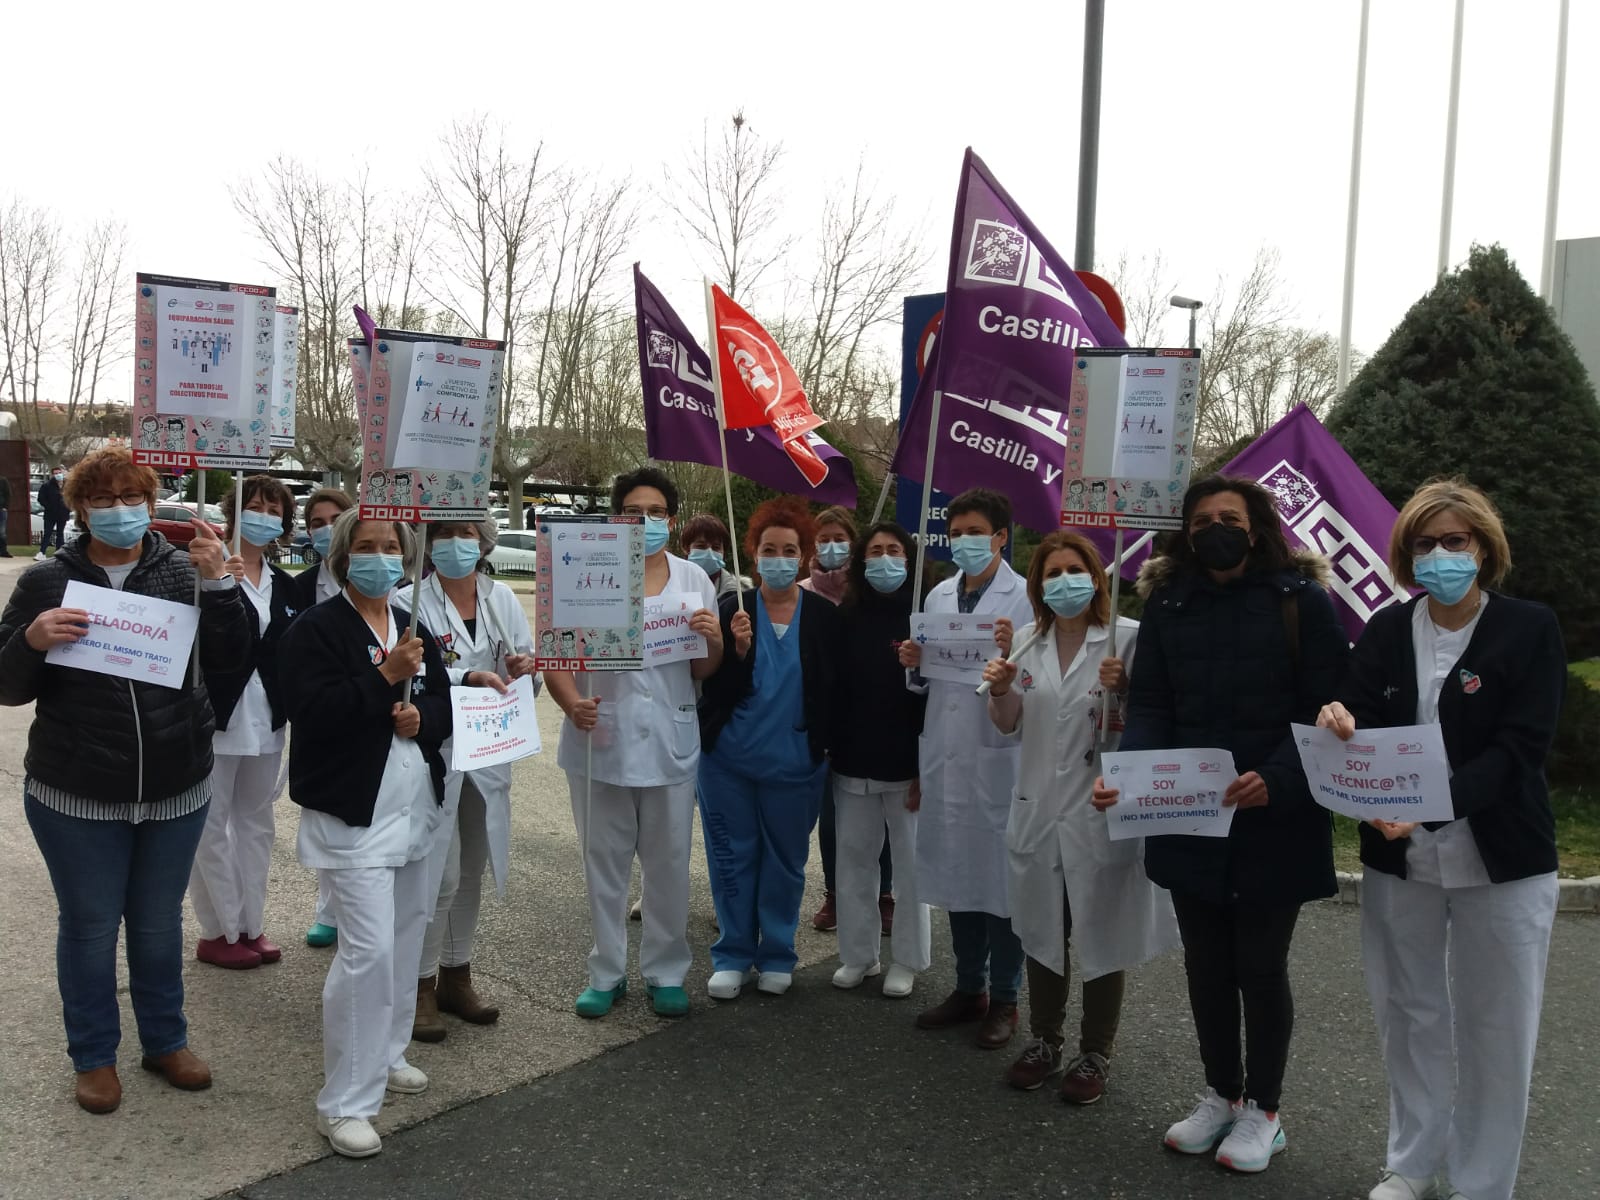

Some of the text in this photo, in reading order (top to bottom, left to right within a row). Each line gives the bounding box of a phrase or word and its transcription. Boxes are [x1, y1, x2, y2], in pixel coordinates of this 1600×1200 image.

[660, 385, 717, 420] Casti
[950, 420, 1063, 485] Castilla y
[117, 601, 147, 617] SOY
[87, 612, 169, 641] CELADOR/A
[643, 615, 689, 631] ADOR/A
[654, 638, 676, 648] MISMO
[103, 642, 112, 651] EL
[113, 644, 142, 658] MISMO
[144, 652, 172, 665] TRATO!
[1346, 759, 1371, 772] SOY
[1153, 780, 1176, 790] SOY
[1331, 772, 1395, 791] TÉCNIC@
[1136, 795, 1196, 807] TÉCNIC@
[1336, 789, 1350, 801] ME
[1351, 794, 1423, 805] DISCRIMINES!
[1140, 812, 1155, 821] ME
[1157, 809, 1219, 819] DISCRIMINES!
